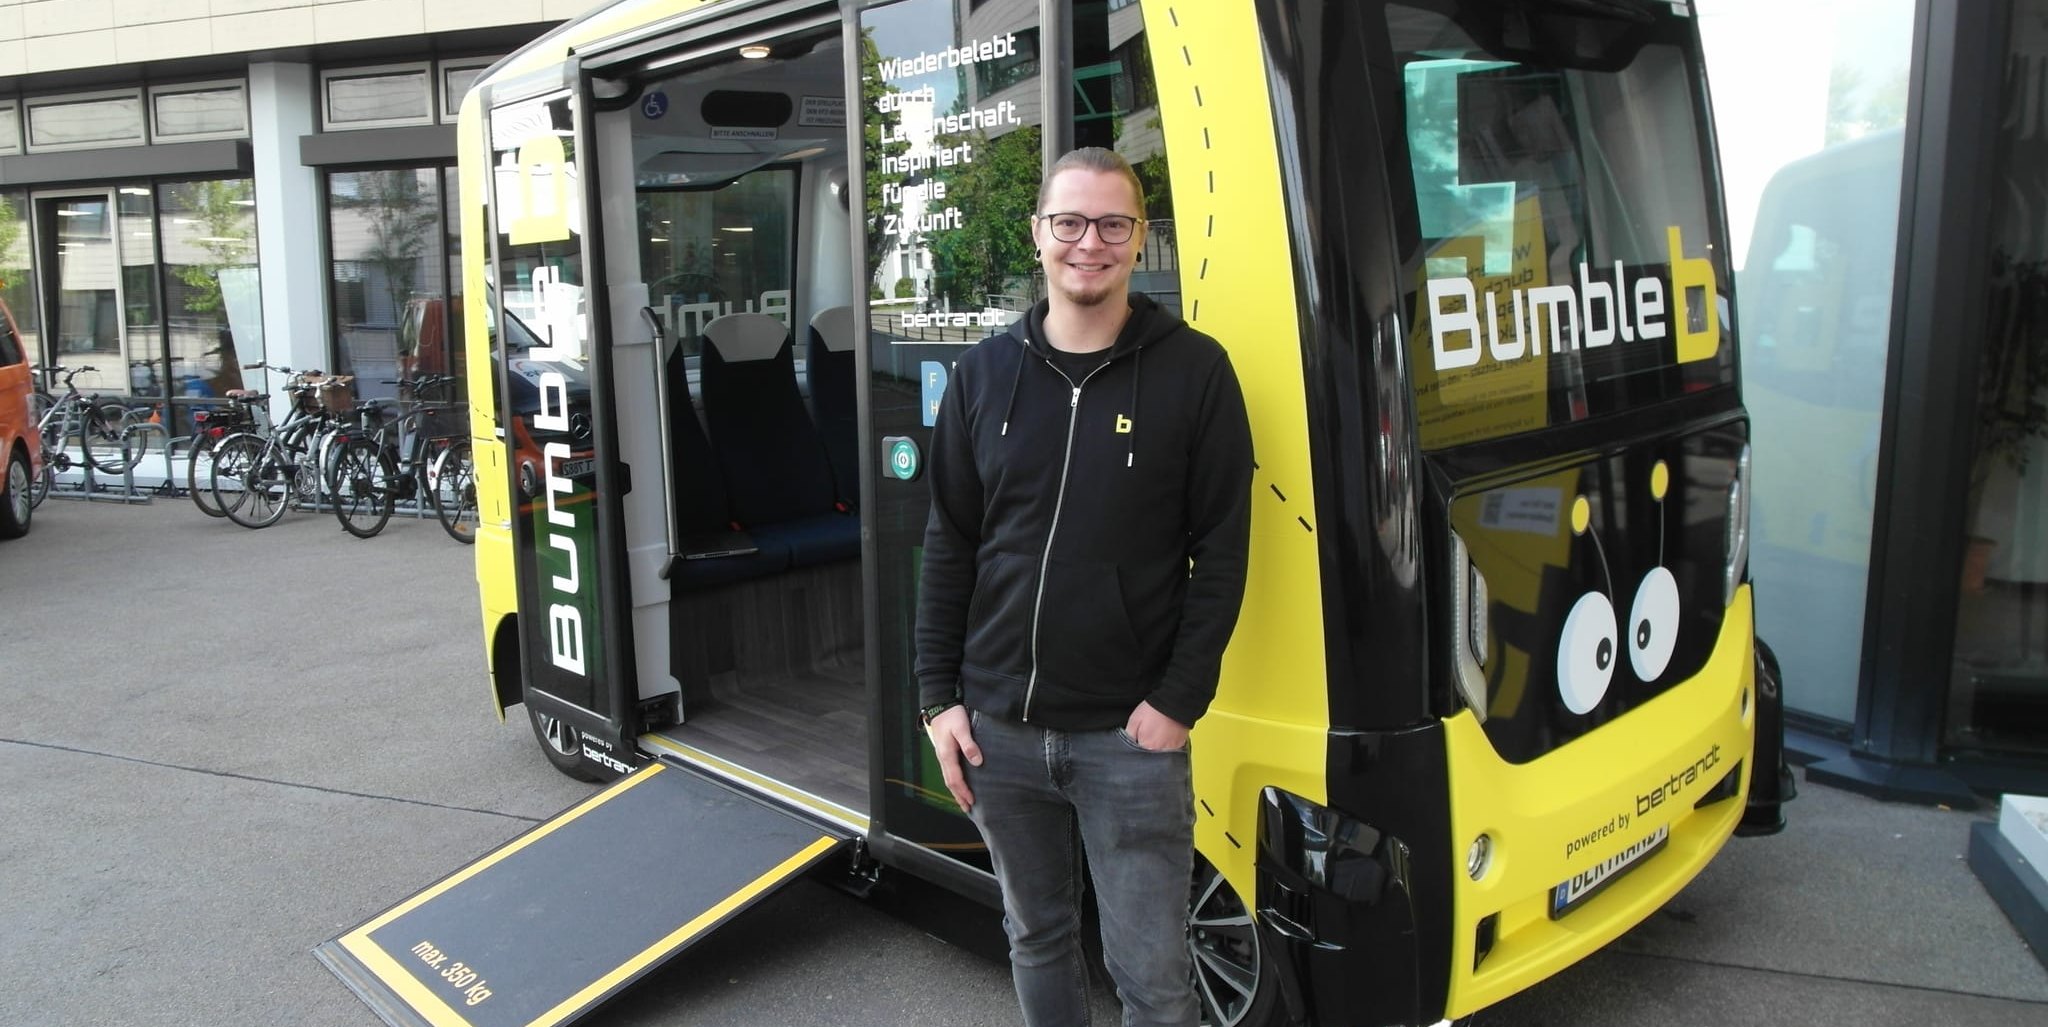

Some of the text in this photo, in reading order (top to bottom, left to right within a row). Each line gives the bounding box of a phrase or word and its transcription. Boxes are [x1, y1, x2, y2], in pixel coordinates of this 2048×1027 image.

[878, 32, 1016, 82] Wiederbelebt
[879, 83, 936, 114] durch
[880, 100, 1022, 144] Lenschaft,
[881, 141, 972, 177] inspiriert
[917, 177, 946, 201] die
[901, 308, 1006, 328] bertrandt
[1427, 226, 1720, 371] Bumble b
[1115, 413, 1132, 434] b
[528, 265, 586, 676] Bumble
[1566, 743, 1721, 860] powered by bertrandt
[411, 940, 493, 1006] max. 350 kg
